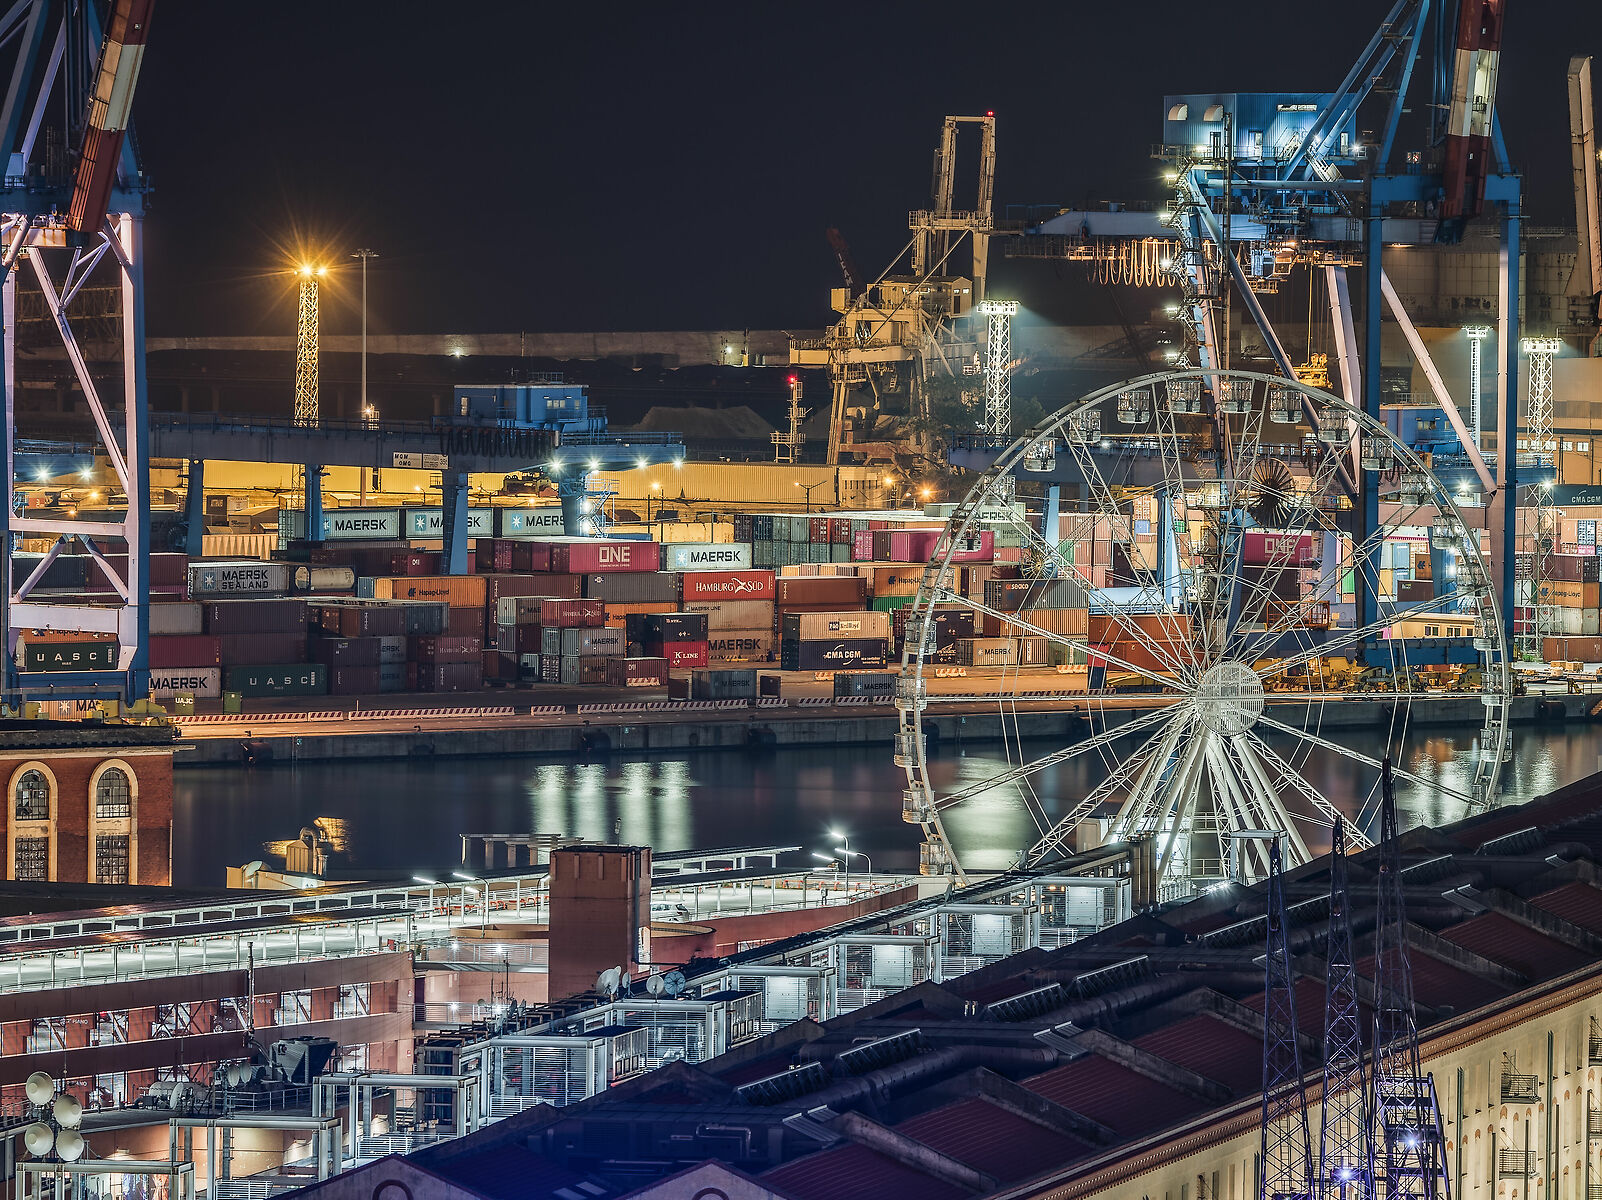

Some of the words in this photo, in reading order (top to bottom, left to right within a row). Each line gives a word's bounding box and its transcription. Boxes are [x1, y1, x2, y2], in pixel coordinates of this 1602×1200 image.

[335, 519, 387, 531] MAERSK
[599, 546, 630, 563] ONE
[690, 551, 741, 563] MAERSK
[222, 570, 269, 581] MAERSK
[222, 581, 269, 590] SEALAND
[695, 582, 734, 593] HAMBURG
[149, 676, 208, 690] MAERSK
